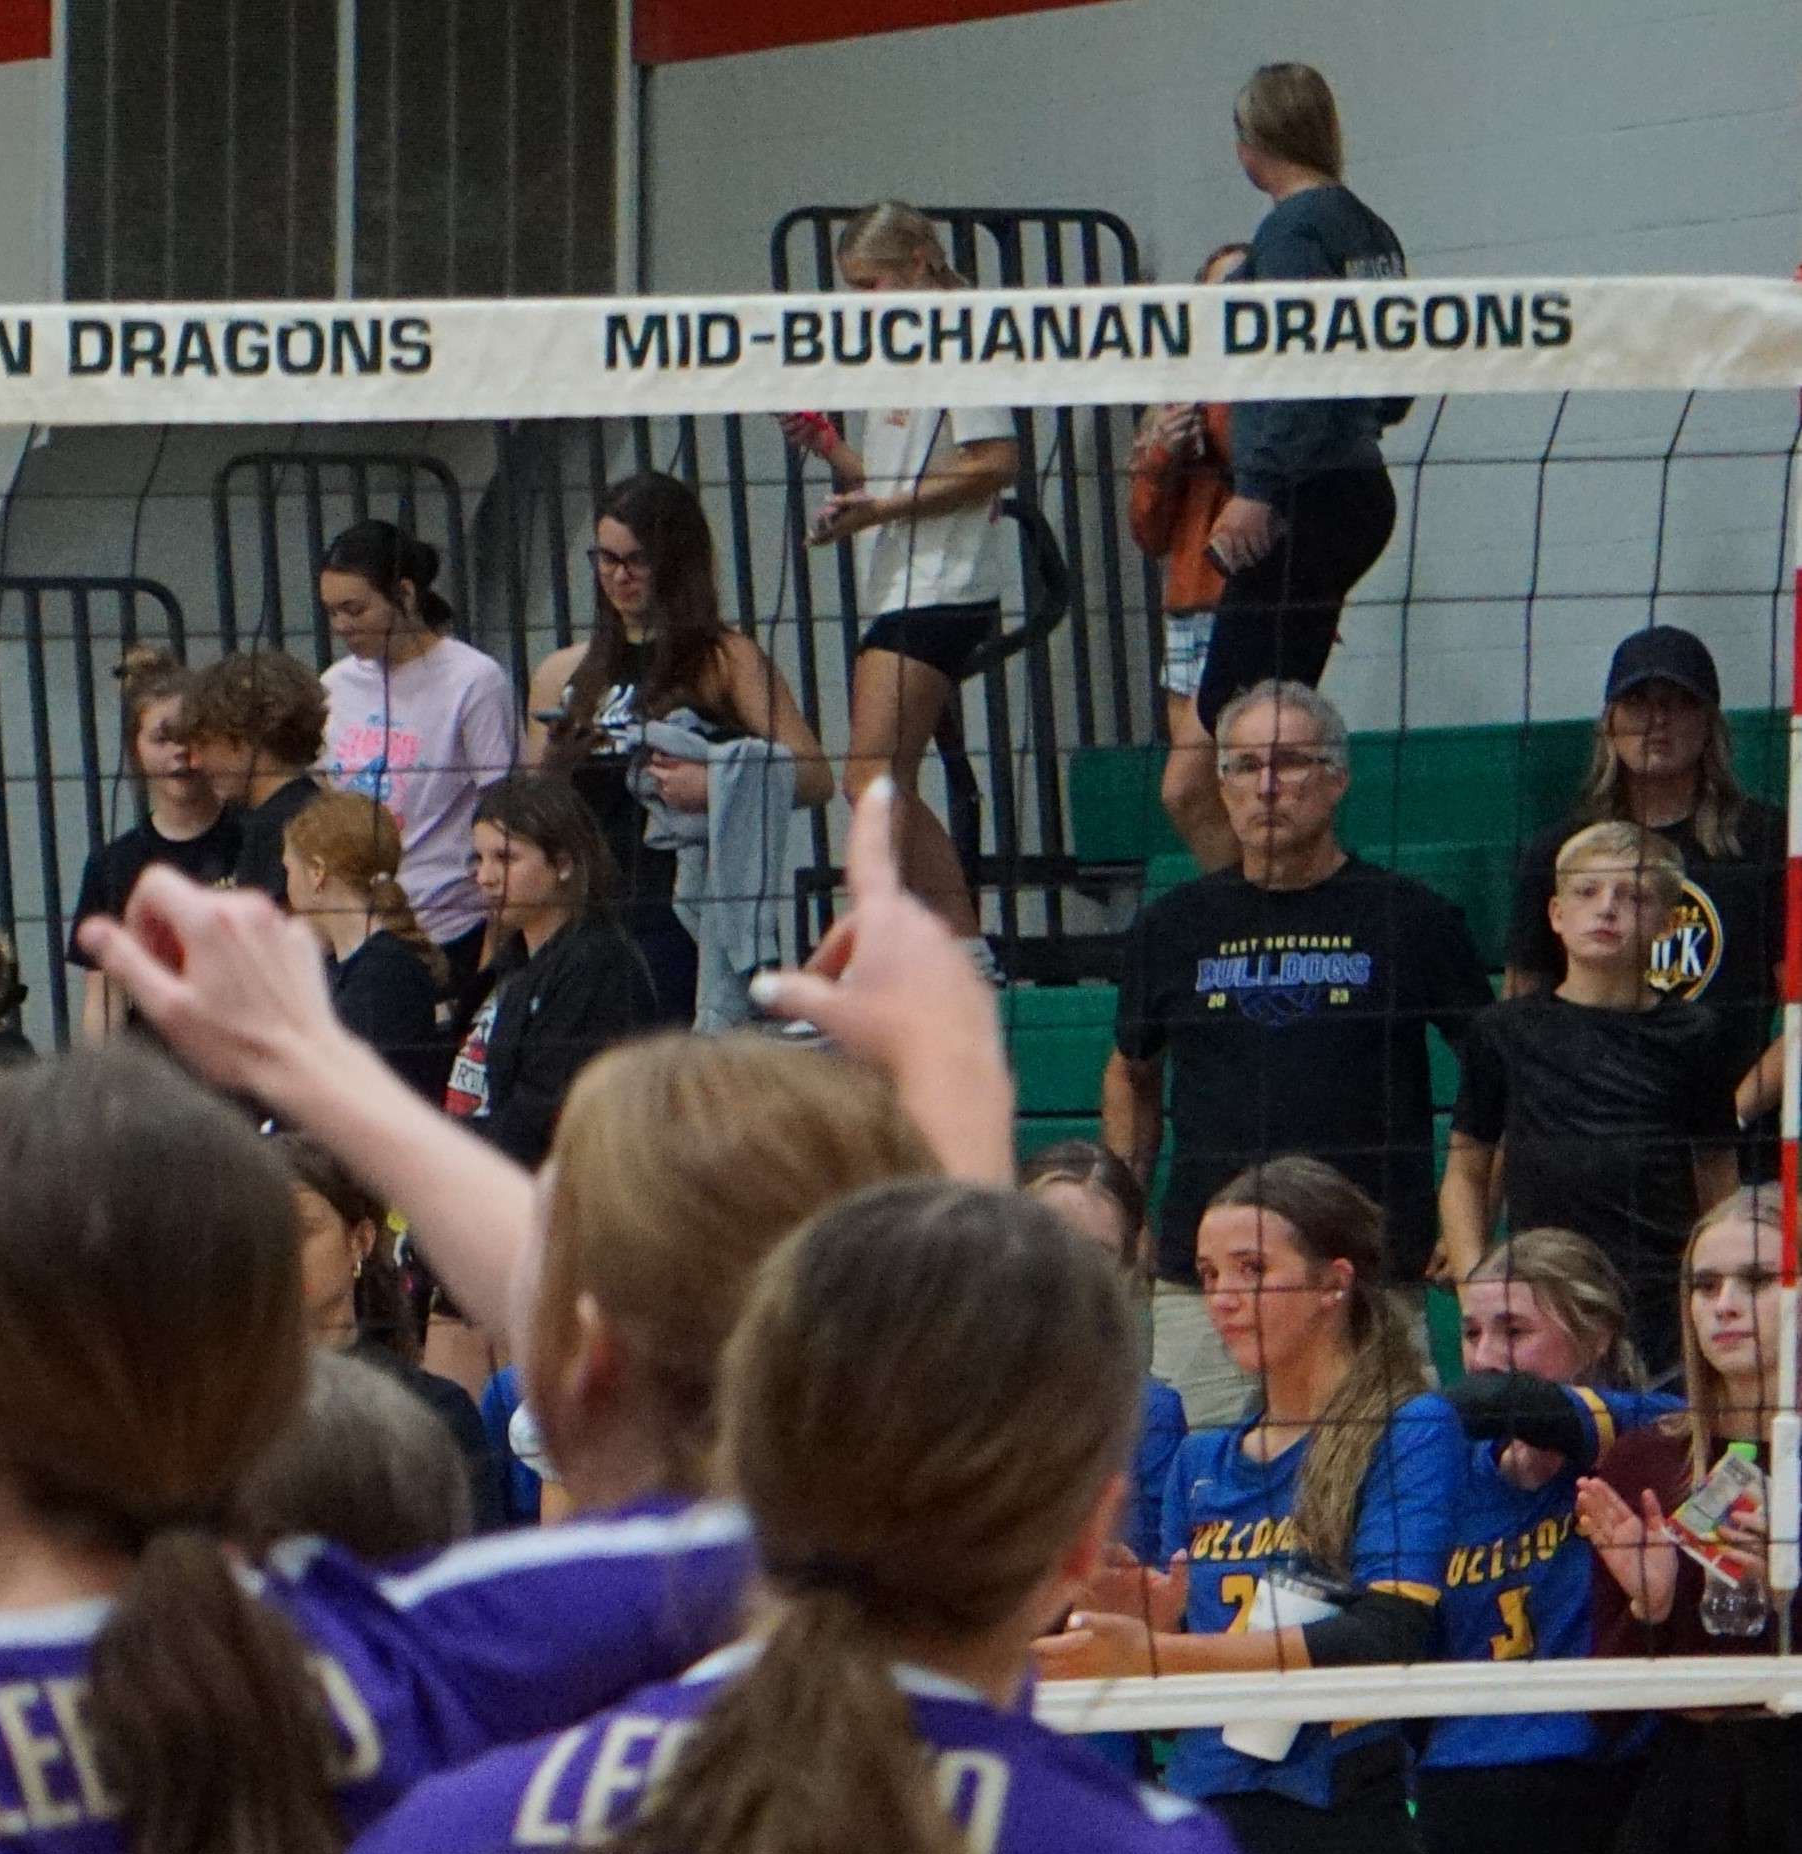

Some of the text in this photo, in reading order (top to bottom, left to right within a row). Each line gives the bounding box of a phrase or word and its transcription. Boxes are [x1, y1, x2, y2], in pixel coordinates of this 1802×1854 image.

[68, 319, 434, 375] DRAGONS
[604, 293, 1573, 370] MID-BUCHANAN DRAGONS
[1219, 935, 1352, 955] EAST BUCHANAN
[1195, 952, 1371, 992] BULLDOGS
